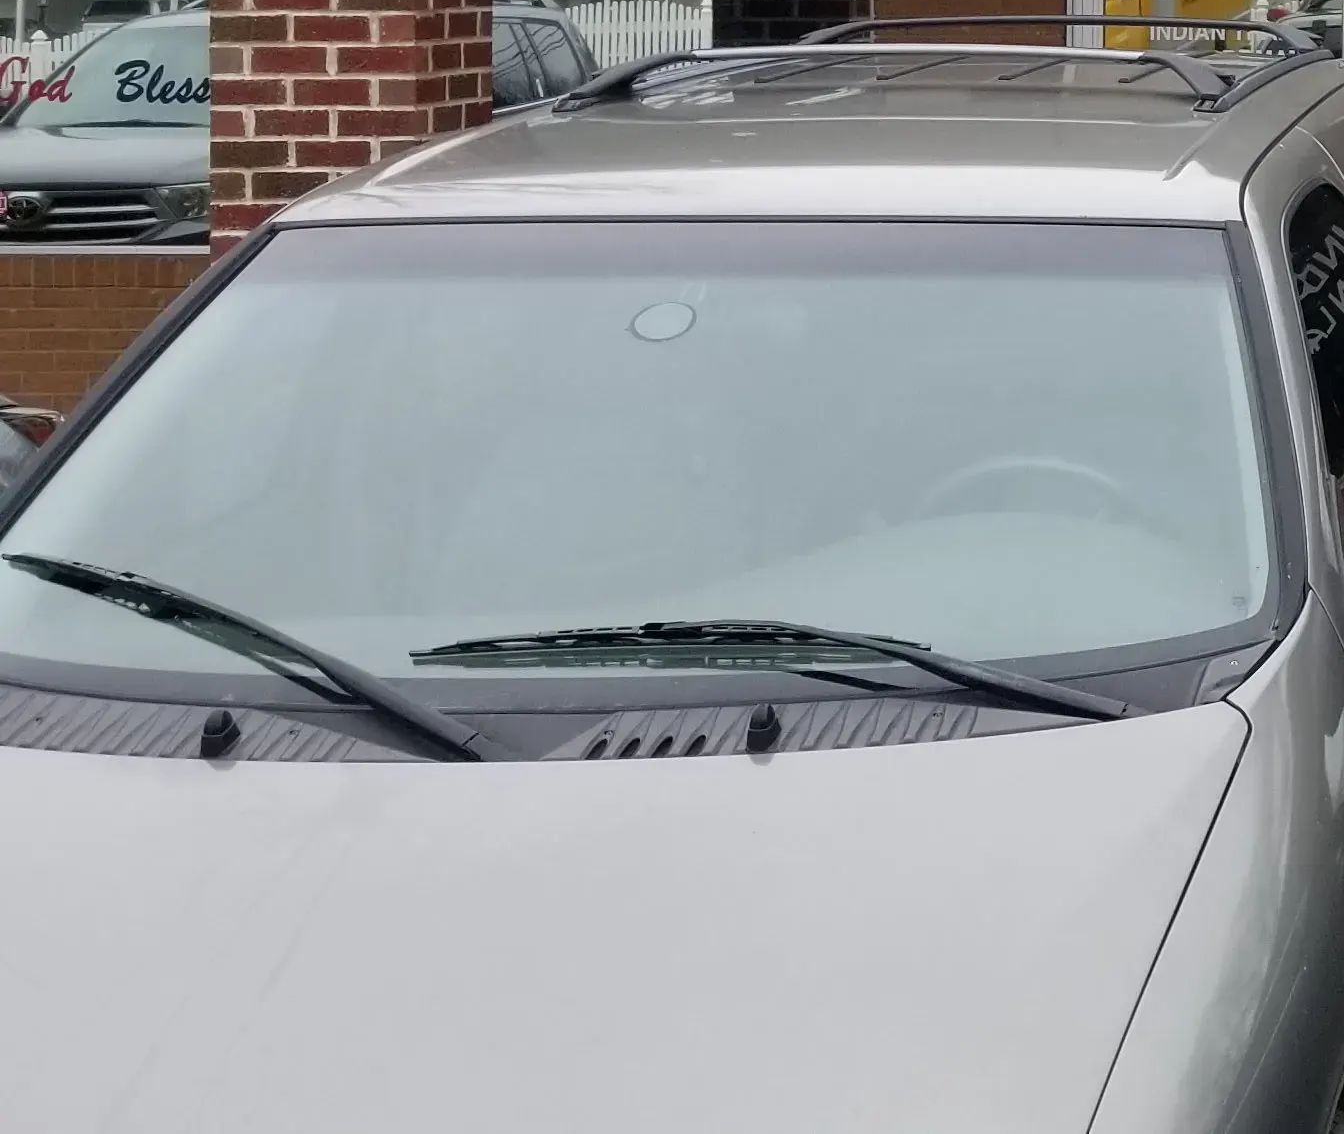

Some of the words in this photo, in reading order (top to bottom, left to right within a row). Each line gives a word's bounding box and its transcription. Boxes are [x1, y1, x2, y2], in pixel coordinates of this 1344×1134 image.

[1150, 26, 1225, 41] INDIAN
[0, 56, 76, 103] God
[115, 60, 210, 104] Bless
